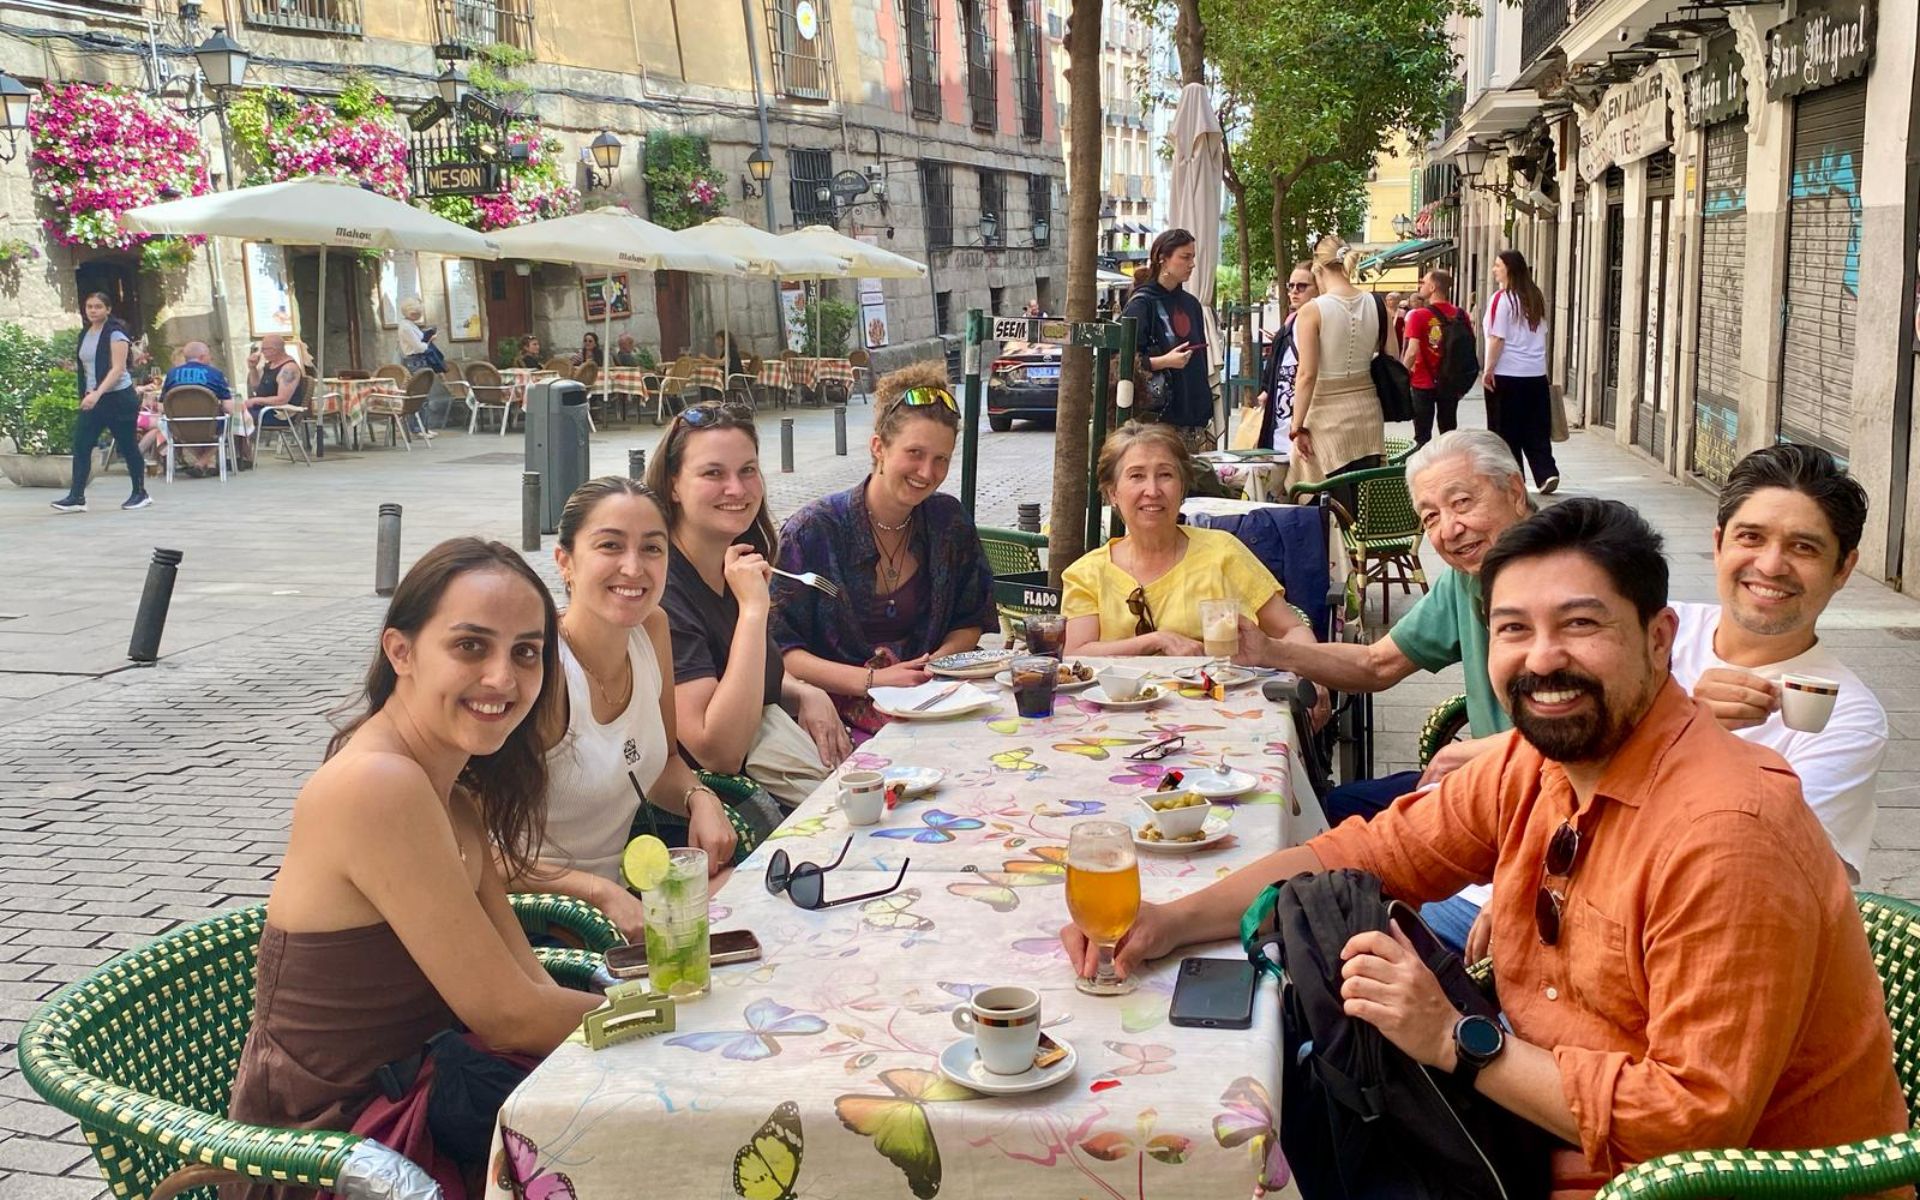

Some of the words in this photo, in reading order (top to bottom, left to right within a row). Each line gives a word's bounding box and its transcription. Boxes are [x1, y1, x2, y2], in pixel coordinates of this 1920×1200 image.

[769, 33, 798, 88] San
[803, 4, 866, 84] Miguel
[467, 99, 493, 121] CAVA
[1608, 93, 1623, 123] EN
[428, 167, 482, 189] MESON
[1023, 590, 1058, 607] FLADO
